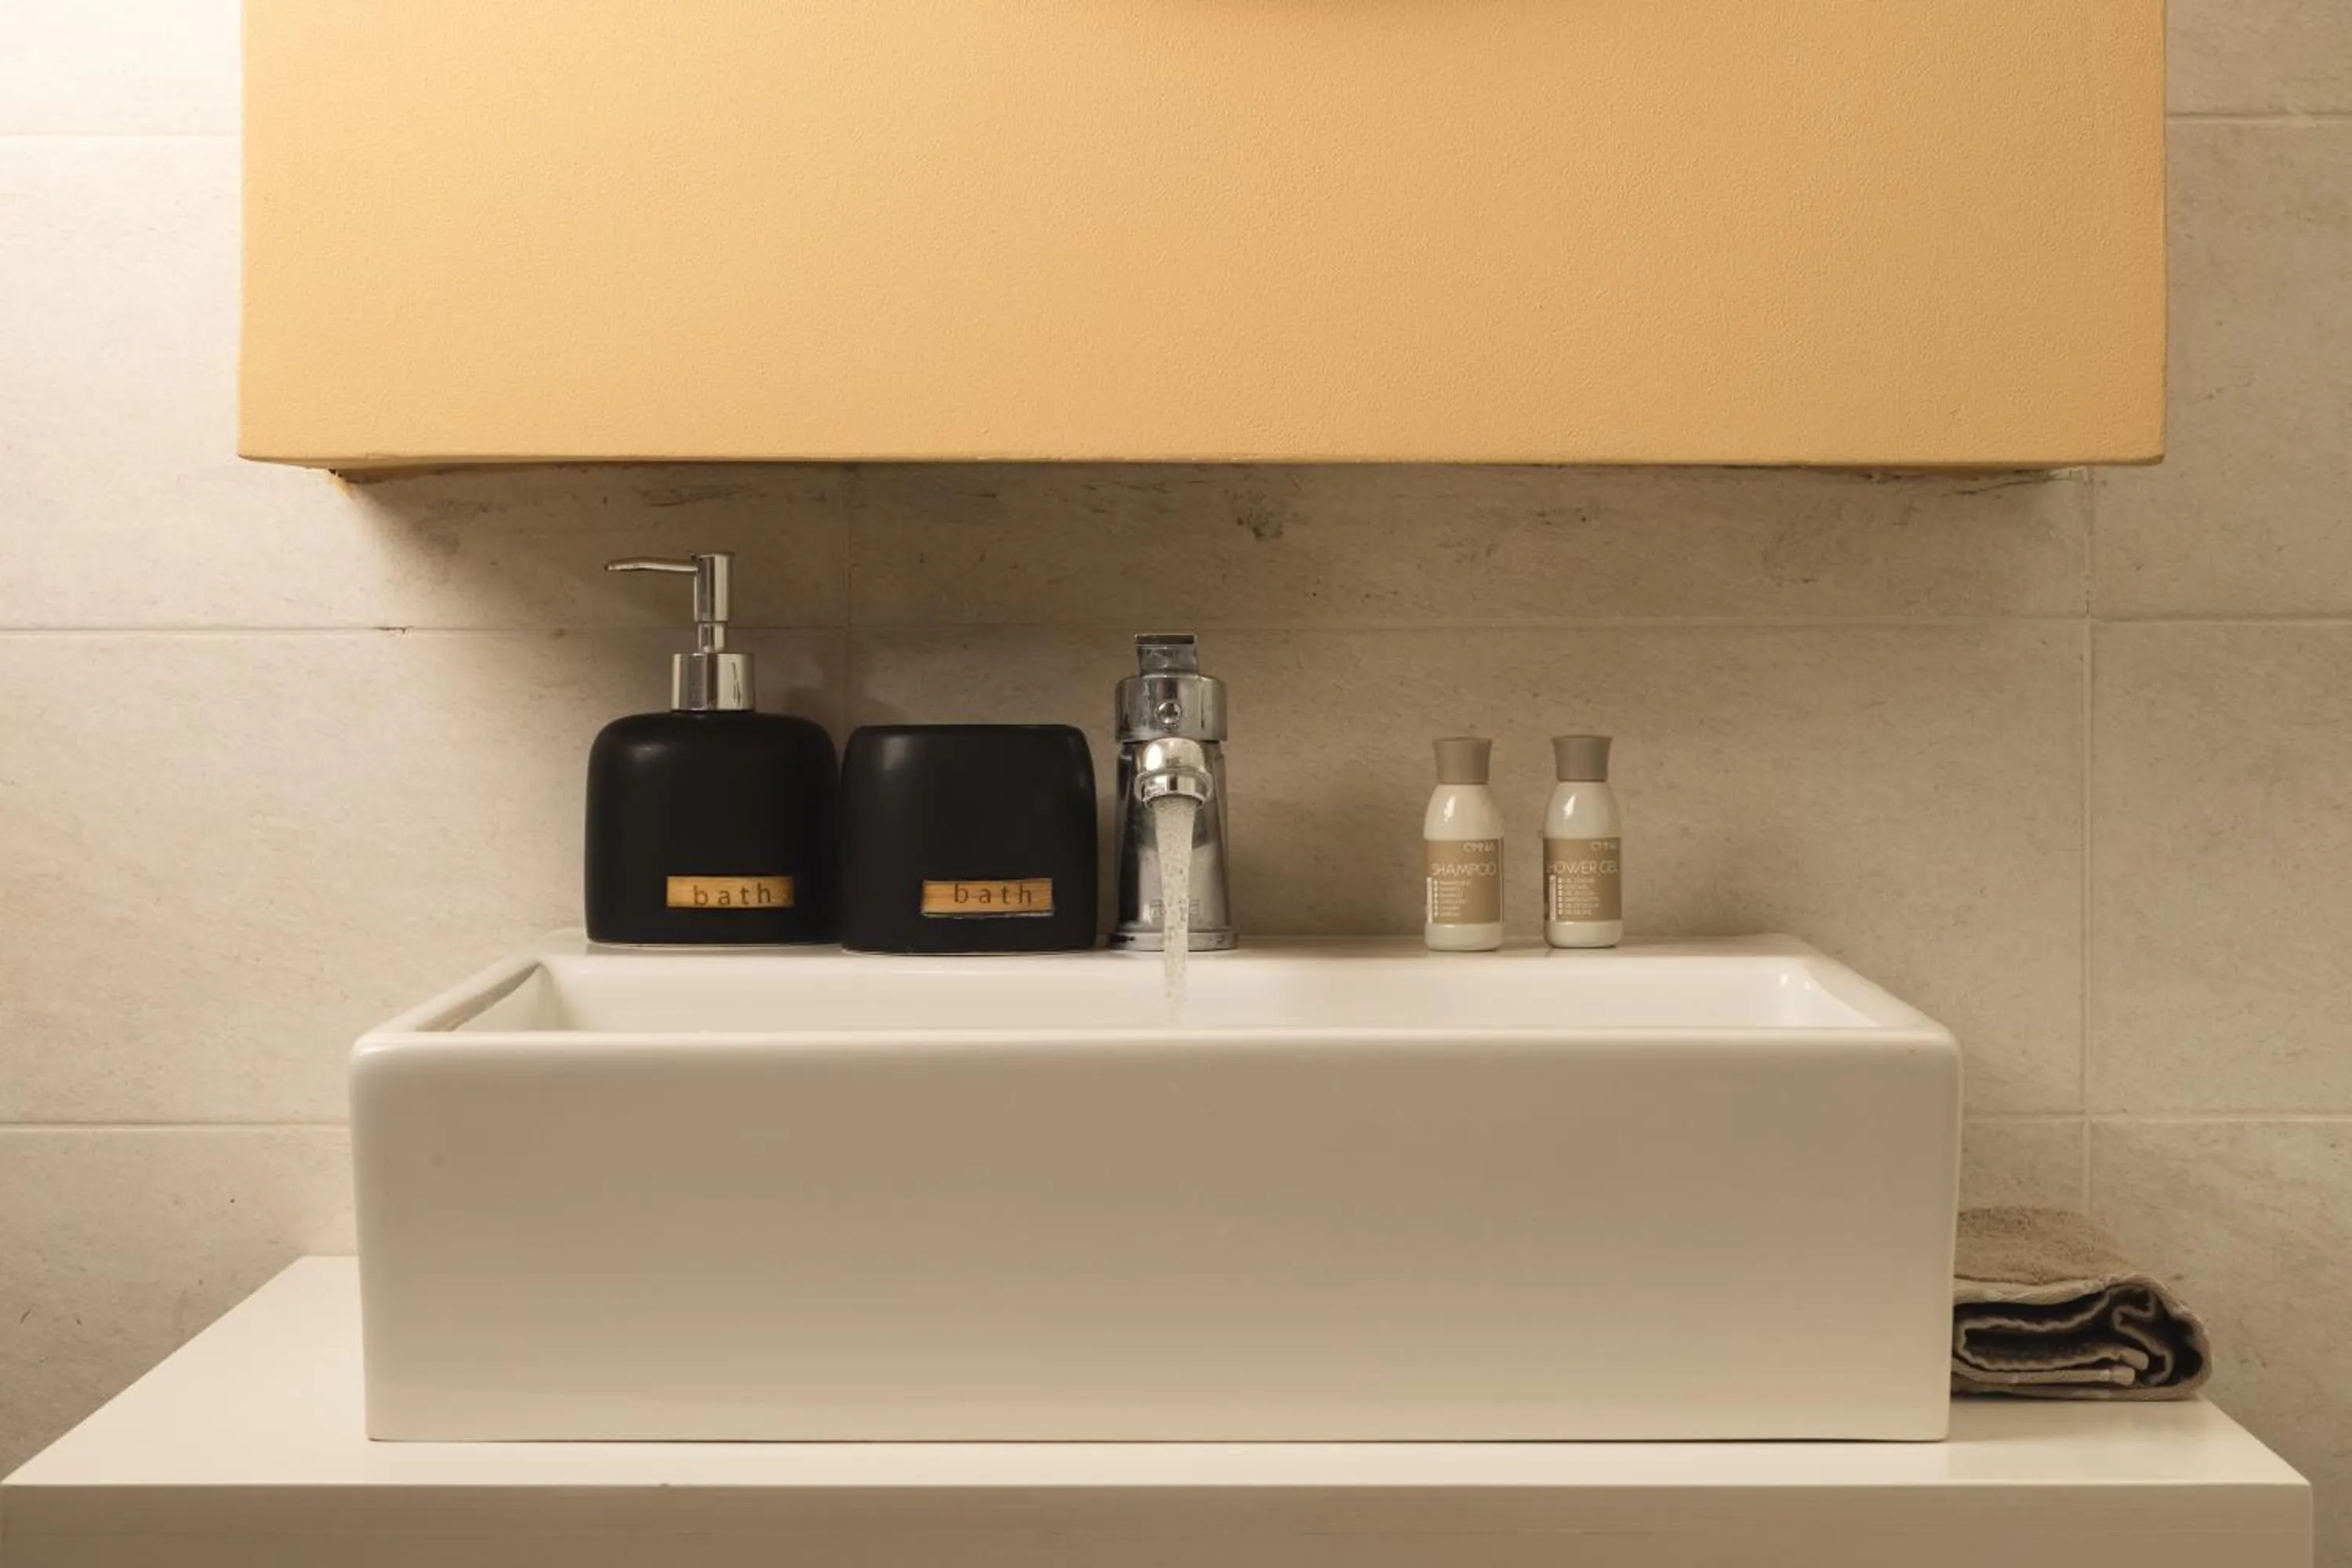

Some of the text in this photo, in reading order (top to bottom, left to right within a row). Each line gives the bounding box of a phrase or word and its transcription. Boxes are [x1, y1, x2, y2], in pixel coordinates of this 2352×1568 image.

[1432, 862, 1497, 877] SHAMPOO
[693, 882, 771, 906] bath
[954, 883, 1032, 905] bath
